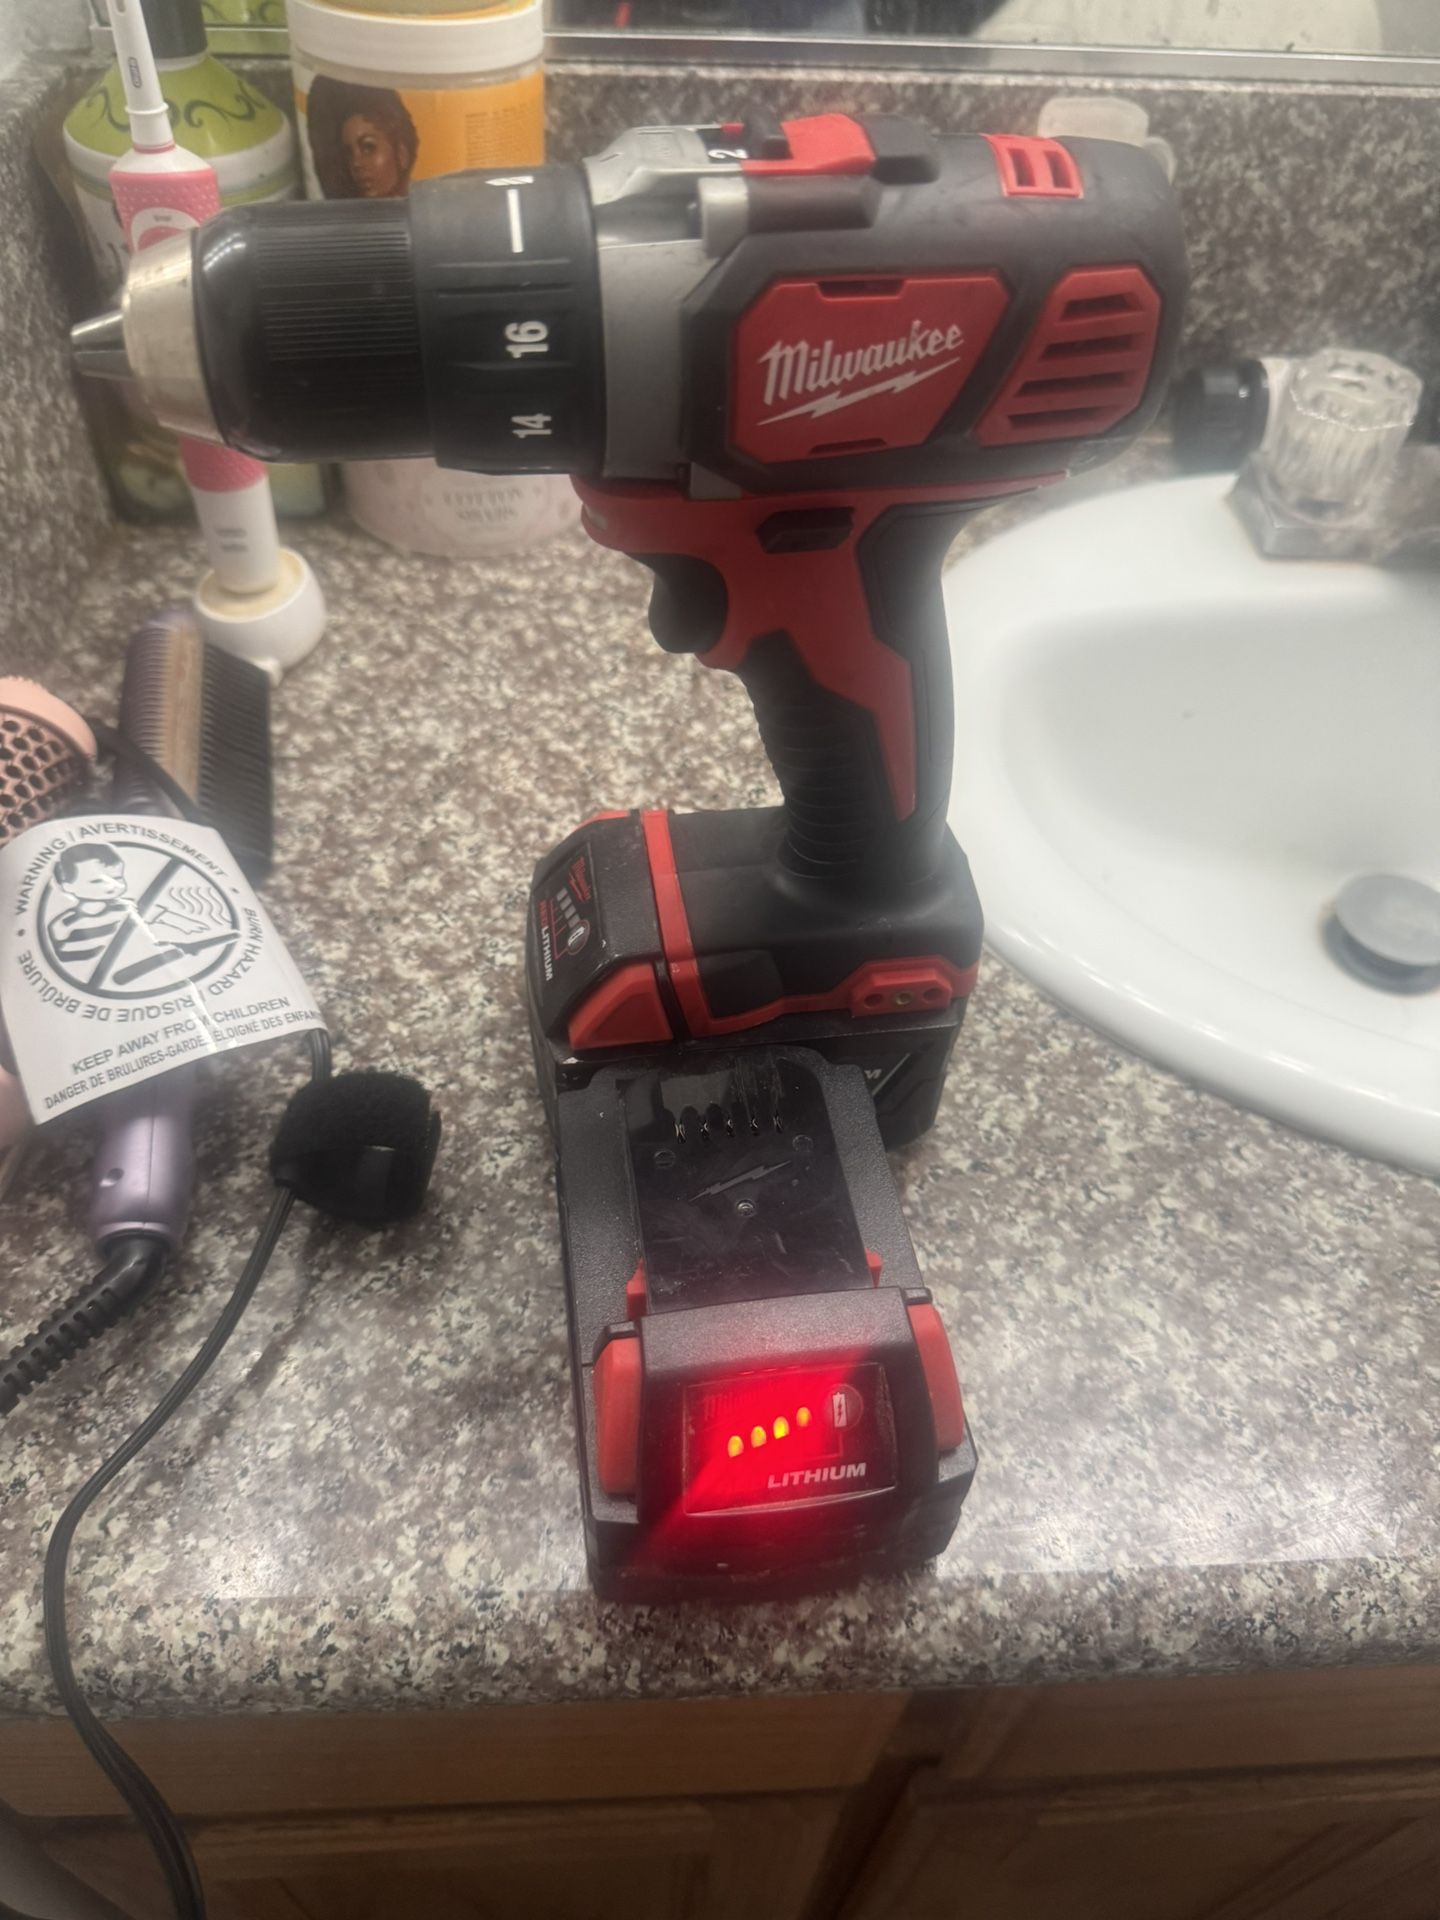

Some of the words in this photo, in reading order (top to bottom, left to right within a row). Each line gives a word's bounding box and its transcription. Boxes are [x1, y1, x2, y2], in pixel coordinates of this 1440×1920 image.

[505, 320, 548, 358] 16
[757, 319, 966, 406] Milwaukee
[511, 413, 552, 438] 14
[15, 837, 66, 915] WARNING
[80, 822, 228, 877] AVERTISSEMENT
[244, 907, 264, 943] BURN
[208, 943, 262, 996] HAZARD
[82, 1003, 112, 1022] DE
[117, 994, 196, 1022] RISQUE
[71, 1048, 114, 1075] KEEP
[117, 1031, 161, 1058] AWAY
[213, 997, 290, 1023] CHILDREN
[45, 1081, 89, 1109] DANGER
[90, 1074, 105, 1090] DE
[261, 1015, 284, 1030] DES
[767, 1462, 866, 1489] LITHIUM
